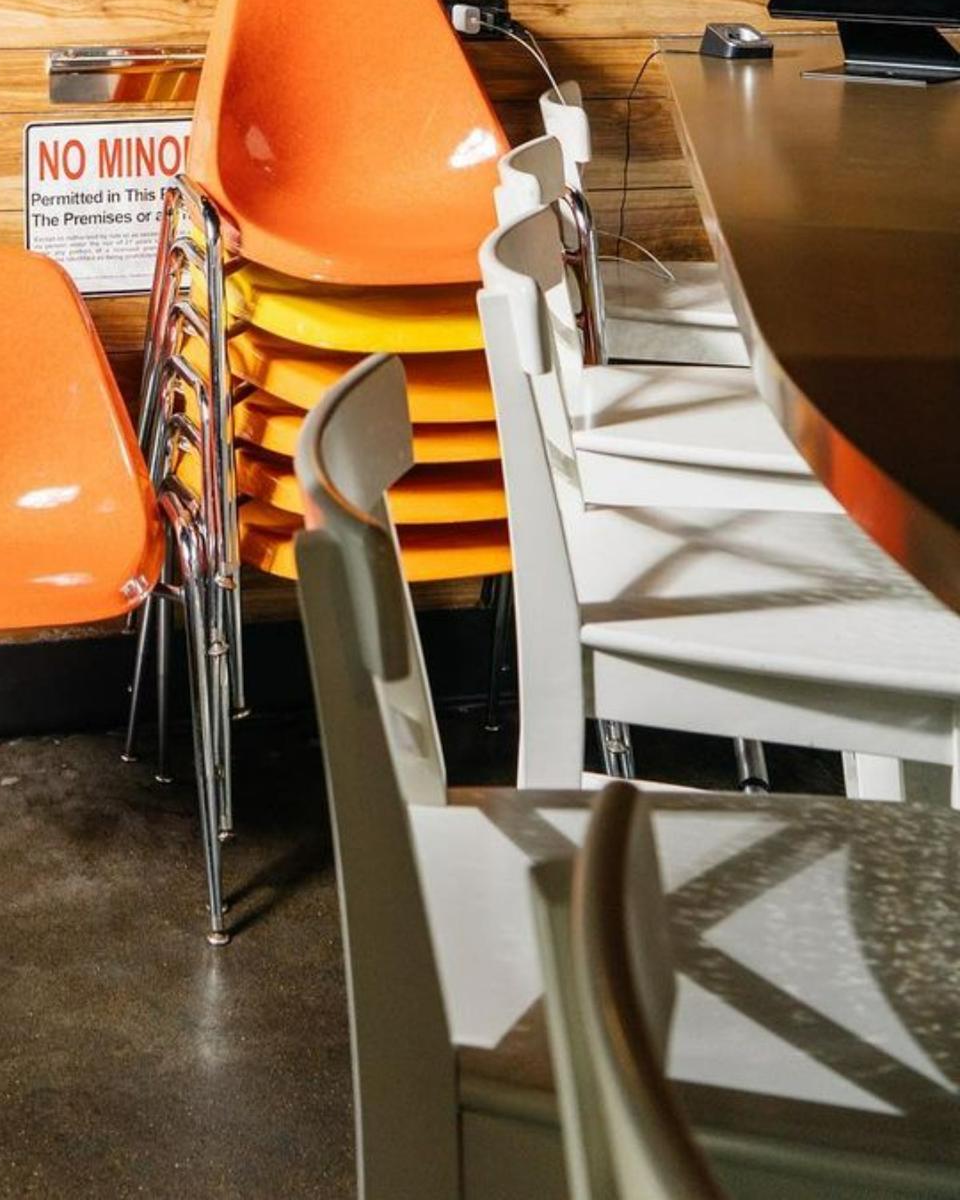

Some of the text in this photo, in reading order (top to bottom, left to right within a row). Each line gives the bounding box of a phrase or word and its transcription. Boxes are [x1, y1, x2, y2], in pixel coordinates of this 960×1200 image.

[39, 139, 86, 181] NO
[31, 190, 103, 207] Permitted
[107, 190, 120, 203] in
[125, 187, 156, 202] This
[32, 213, 59, 227] The
[63, 211, 133, 226] Premises
